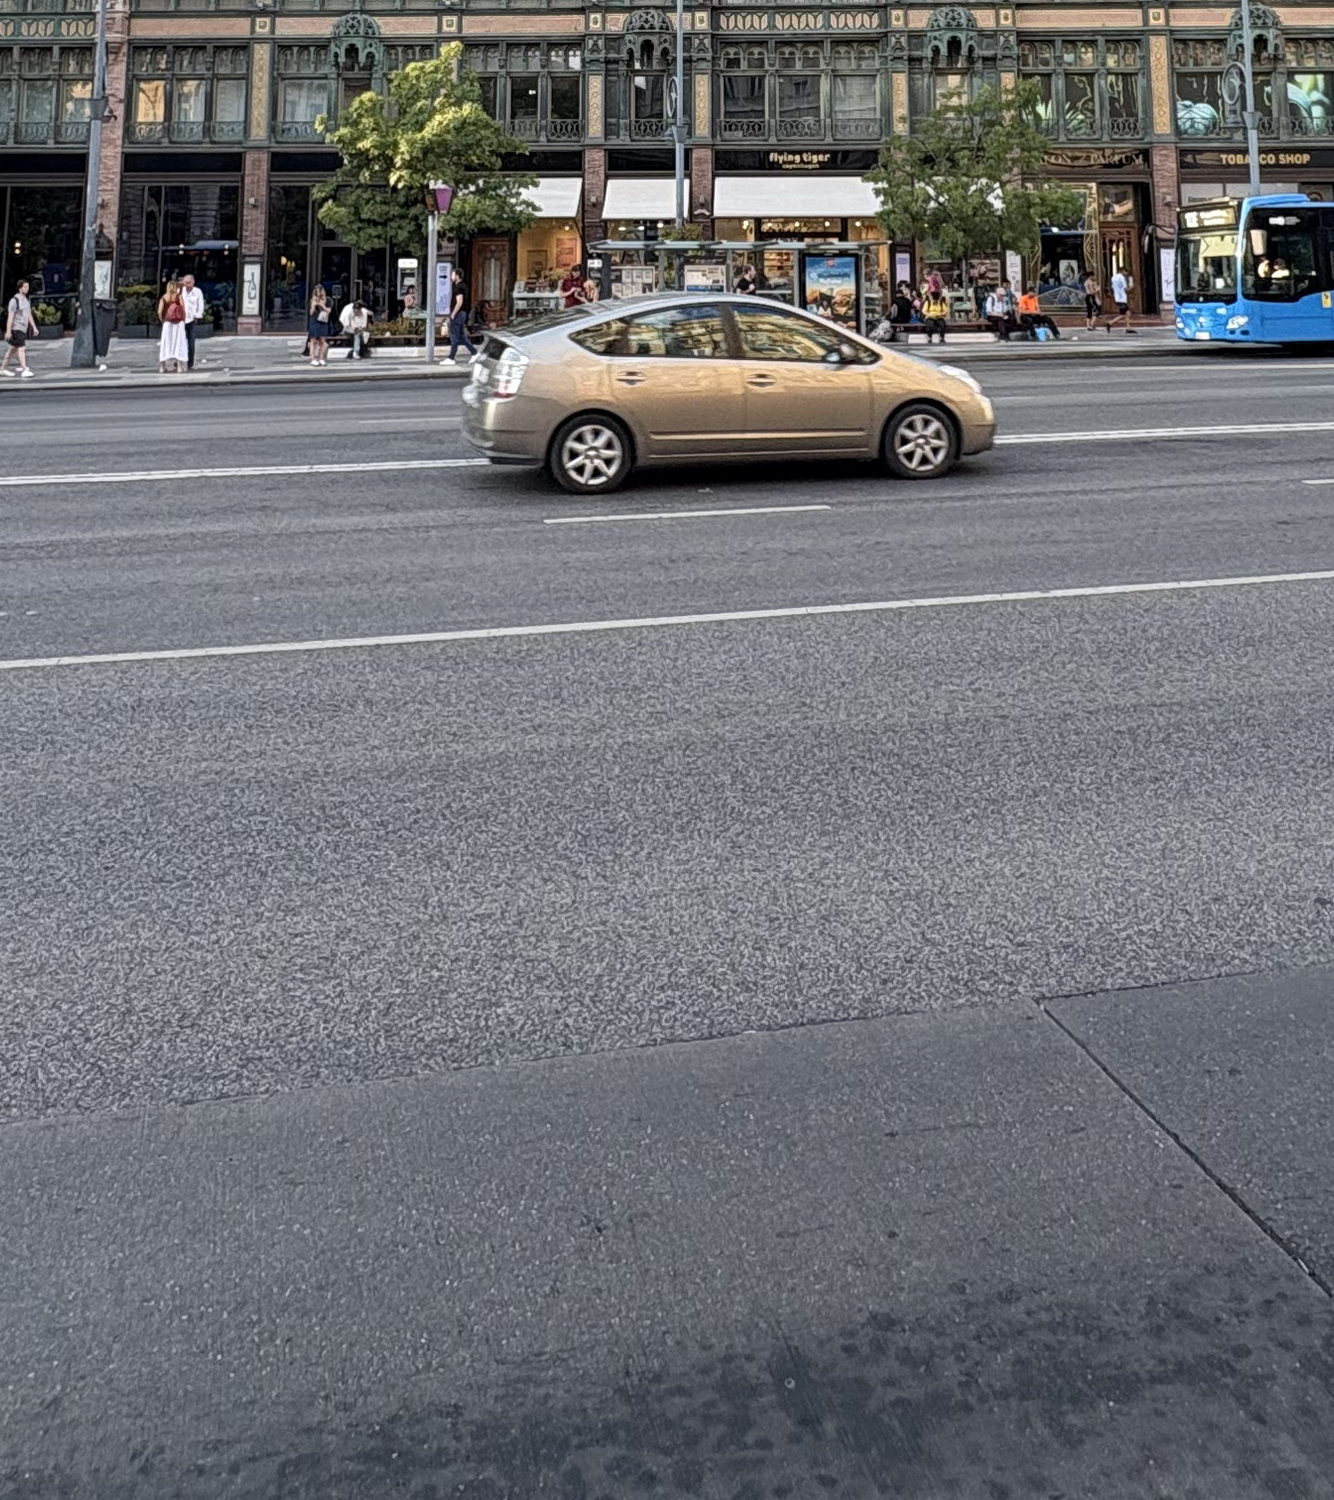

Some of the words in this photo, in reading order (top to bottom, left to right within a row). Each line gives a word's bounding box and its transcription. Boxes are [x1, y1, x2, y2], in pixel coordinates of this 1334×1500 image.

[769, 152, 801, 164] flying
[802, 152, 831, 164] tiger
[1220, 154, 1276, 165] TOBACO
[1278, 153, 1311, 164] SHOP
